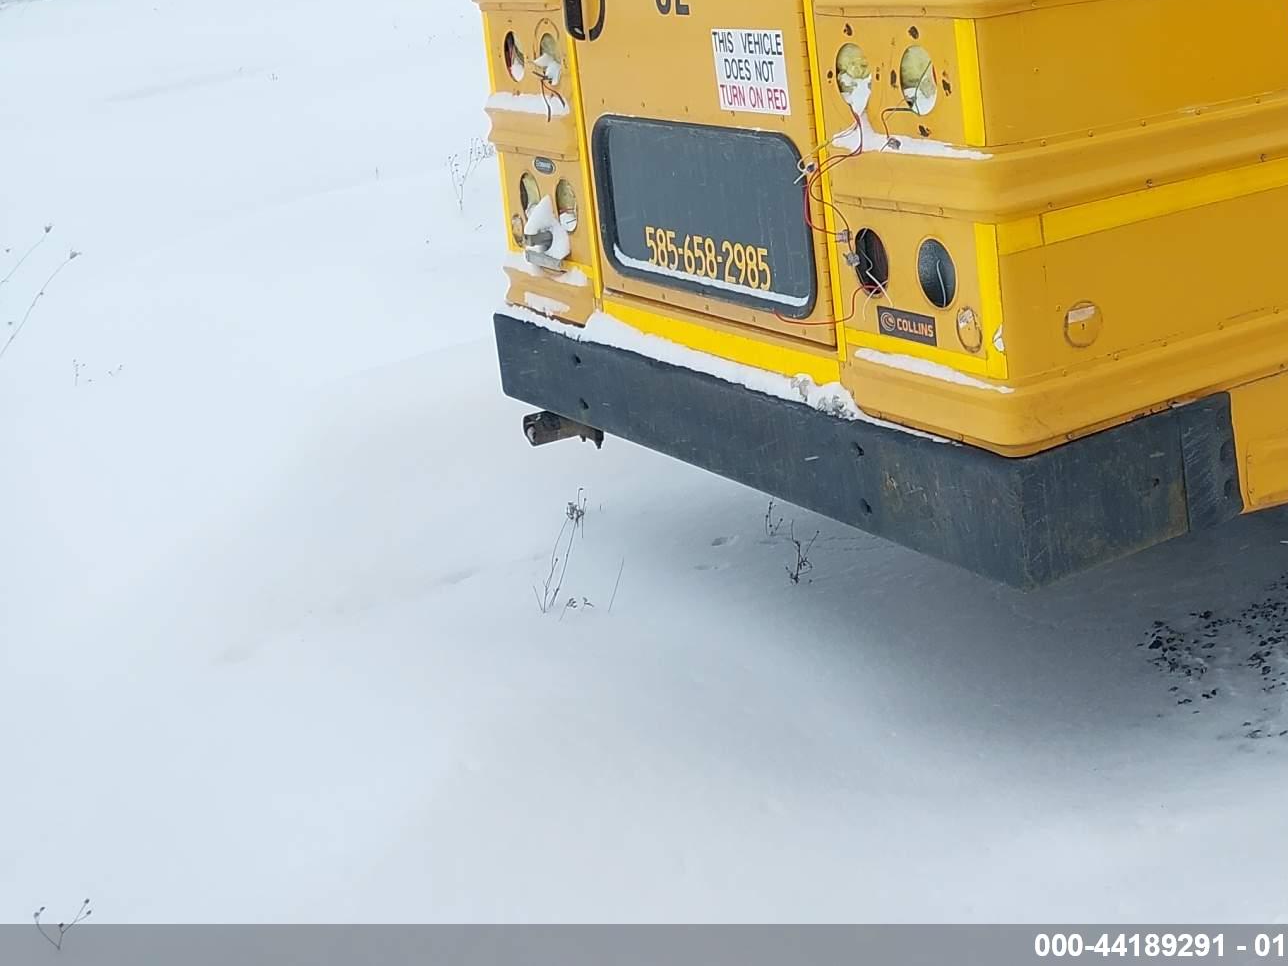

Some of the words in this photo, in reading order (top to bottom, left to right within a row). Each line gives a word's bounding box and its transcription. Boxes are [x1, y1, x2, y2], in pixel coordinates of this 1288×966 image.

[712, 31, 734, 54] THIS
[740, 33, 783, 56] VEHICLE
[724, 58, 751, 81] DOES
[754, 60, 774, 83] NOT
[720, 84, 746, 107] TURN
[748, 86, 764, 109] ON
[766, 88, 788, 111] RED
[645, 225, 771, 291] 585-658-2985
[896, 317, 934, 338] COLLINS
